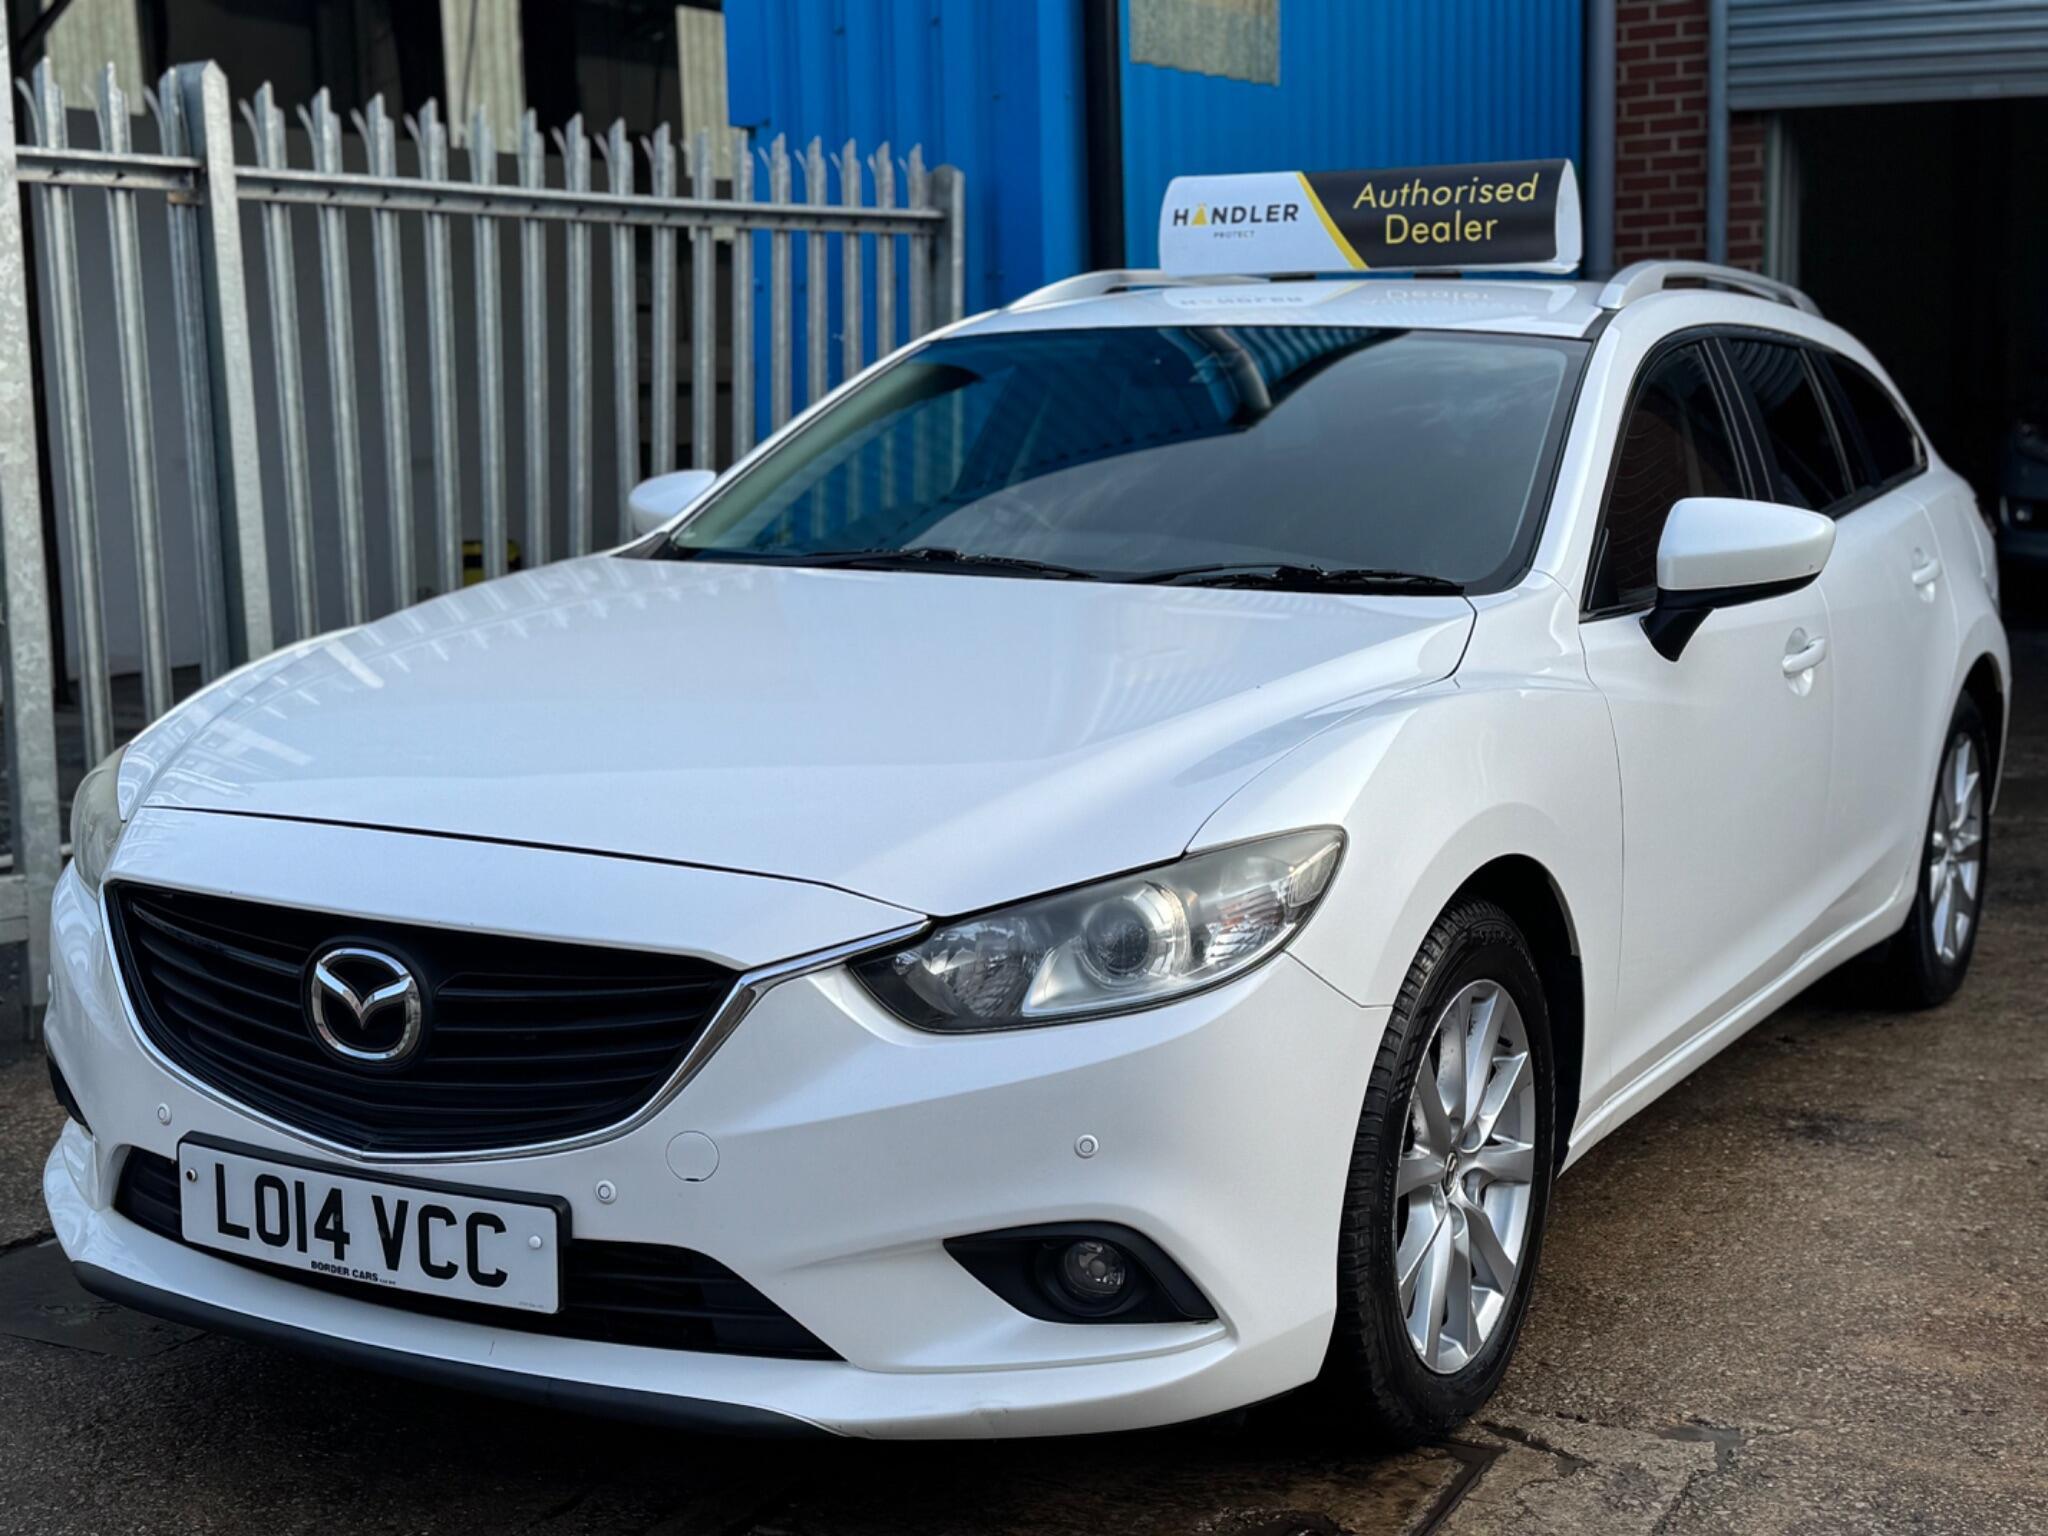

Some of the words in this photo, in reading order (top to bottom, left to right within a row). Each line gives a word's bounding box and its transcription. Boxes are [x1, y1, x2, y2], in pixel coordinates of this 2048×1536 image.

[1352, 172, 1540, 209] Authorised
[1213, 230, 1255, 239] PROTECT
[1385, 209, 1498, 245] Dealer
[215, 1163, 351, 1261] LO14
[371, 1195, 508, 1288] VCC
[310, 1260, 350, 1277] BORDER
[352, 1269, 379, 1282] CARS
